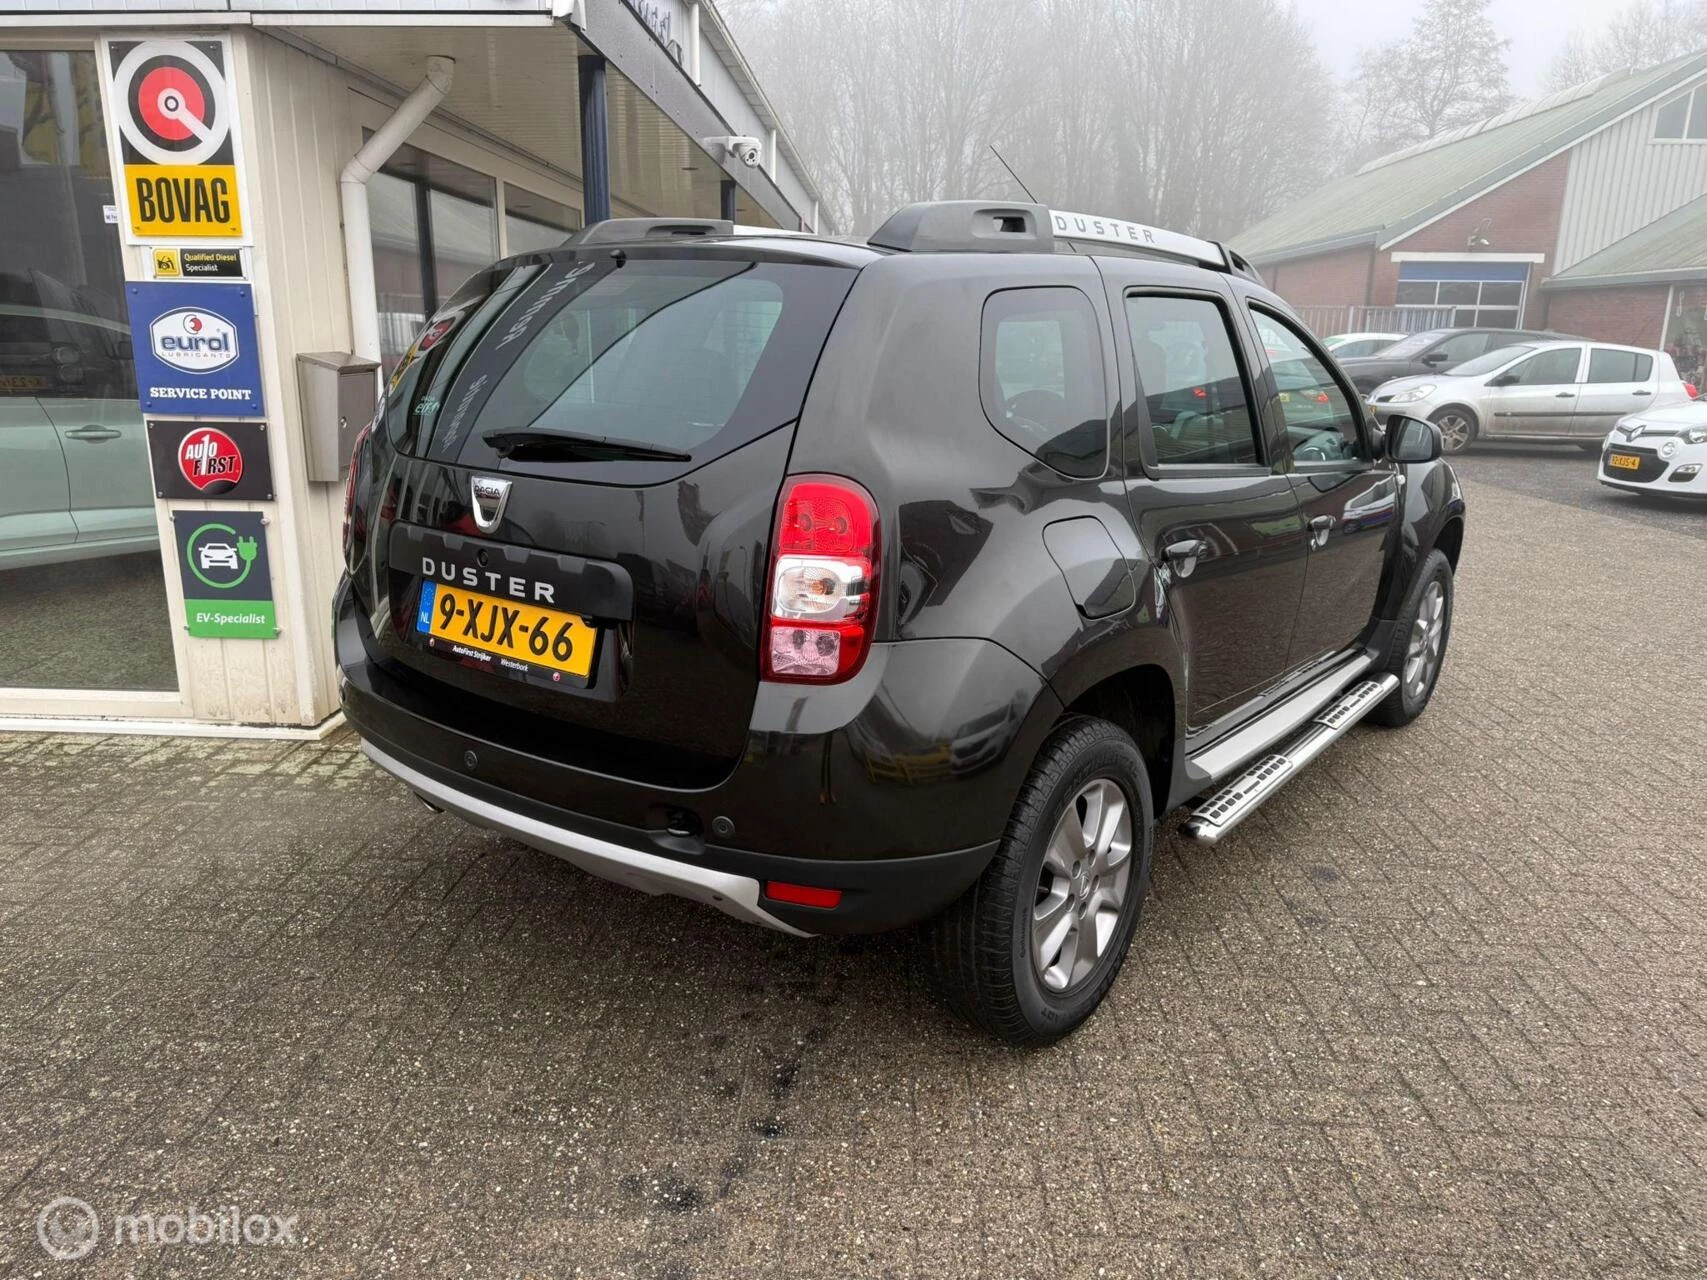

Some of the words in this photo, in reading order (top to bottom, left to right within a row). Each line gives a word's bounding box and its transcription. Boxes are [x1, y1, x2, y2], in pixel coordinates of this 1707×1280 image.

[136, 177, 231, 223] BOVAG
[1054, 215, 1155, 243] DUSTER
[184, 253, 214, 262] Qualified
[215, 253, 237, 262] Diesel
[185, 263, 218, 272] Specialist
[161, 333, 230, 351] eurol
[150, 387, 207, 399] SERVICE
[210, 388, 251, 400] POINT
[474, 485, 500, 495] DACIA
[422, 557, 555, 603] DUSTER
[196, 612, 266, 625] EV-Specialist
[420, 611, 430, 625] NL
[439, 593, 573, 661] 9-XJX-66
[500, 658, 529, 671] Westerbork
